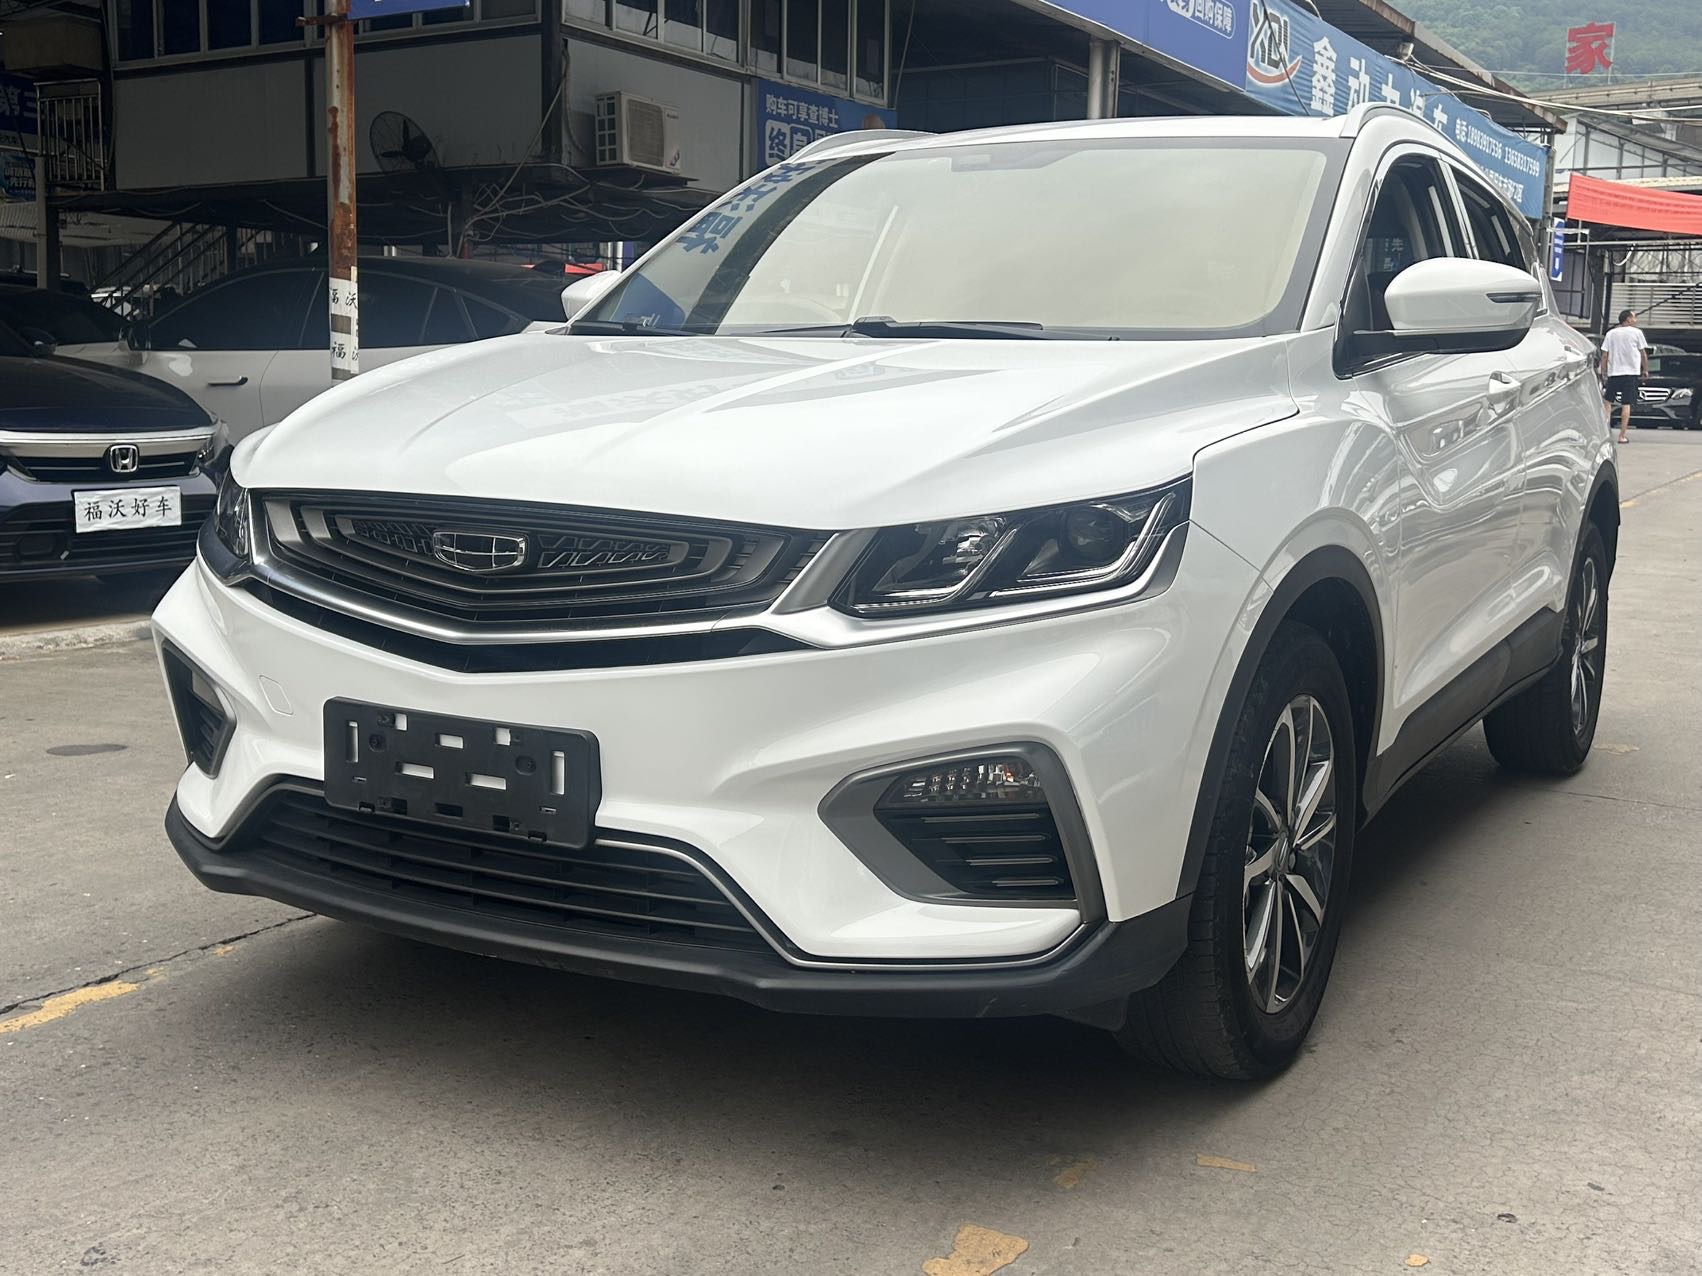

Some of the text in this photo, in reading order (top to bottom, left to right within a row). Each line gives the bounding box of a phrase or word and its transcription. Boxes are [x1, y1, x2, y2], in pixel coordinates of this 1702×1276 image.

[1565, 21, 1615, 74] 家
[765, 94, 839, 129] 购车可享查博士
[84, 496, 172, 522] 福沃好车
